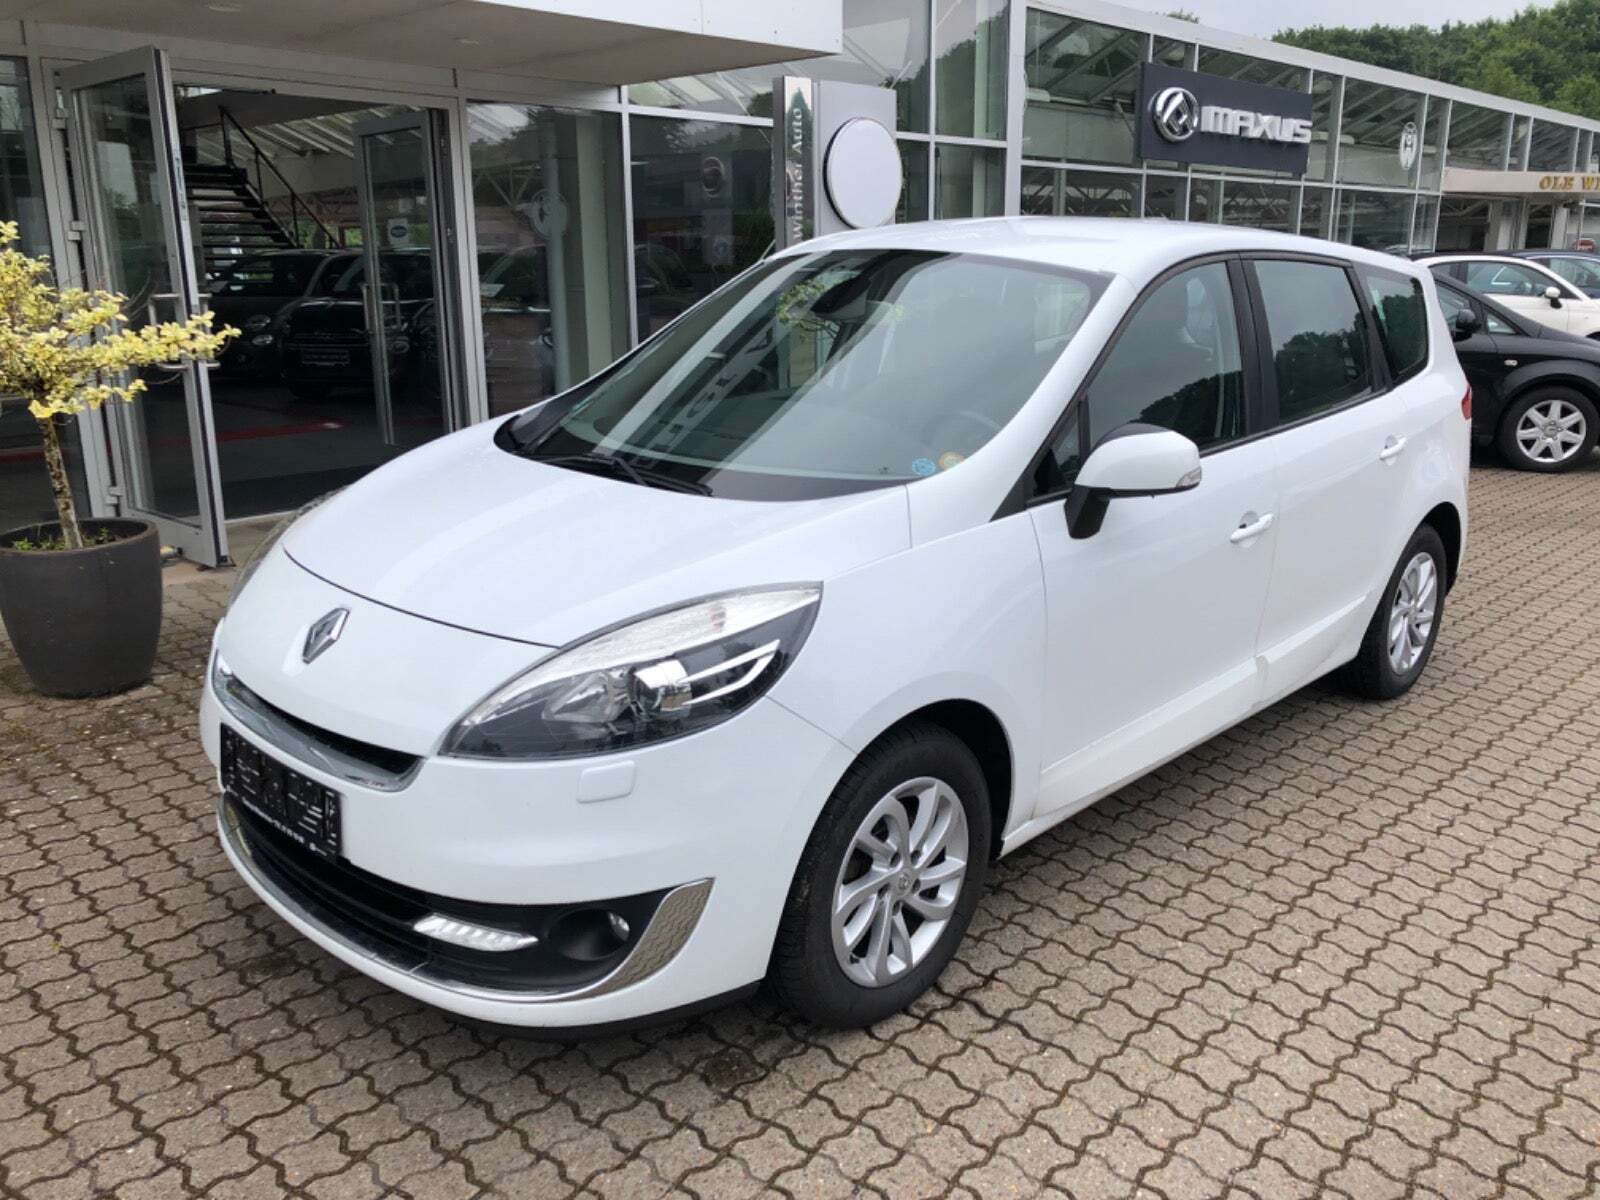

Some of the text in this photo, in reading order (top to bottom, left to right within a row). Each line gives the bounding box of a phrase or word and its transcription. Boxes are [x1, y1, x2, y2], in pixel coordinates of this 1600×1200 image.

[792, 108, 804, 154] Auto
[1201, 105, 1313, 144] MAXUS
[1538, 176, 1575, 191] OLE
